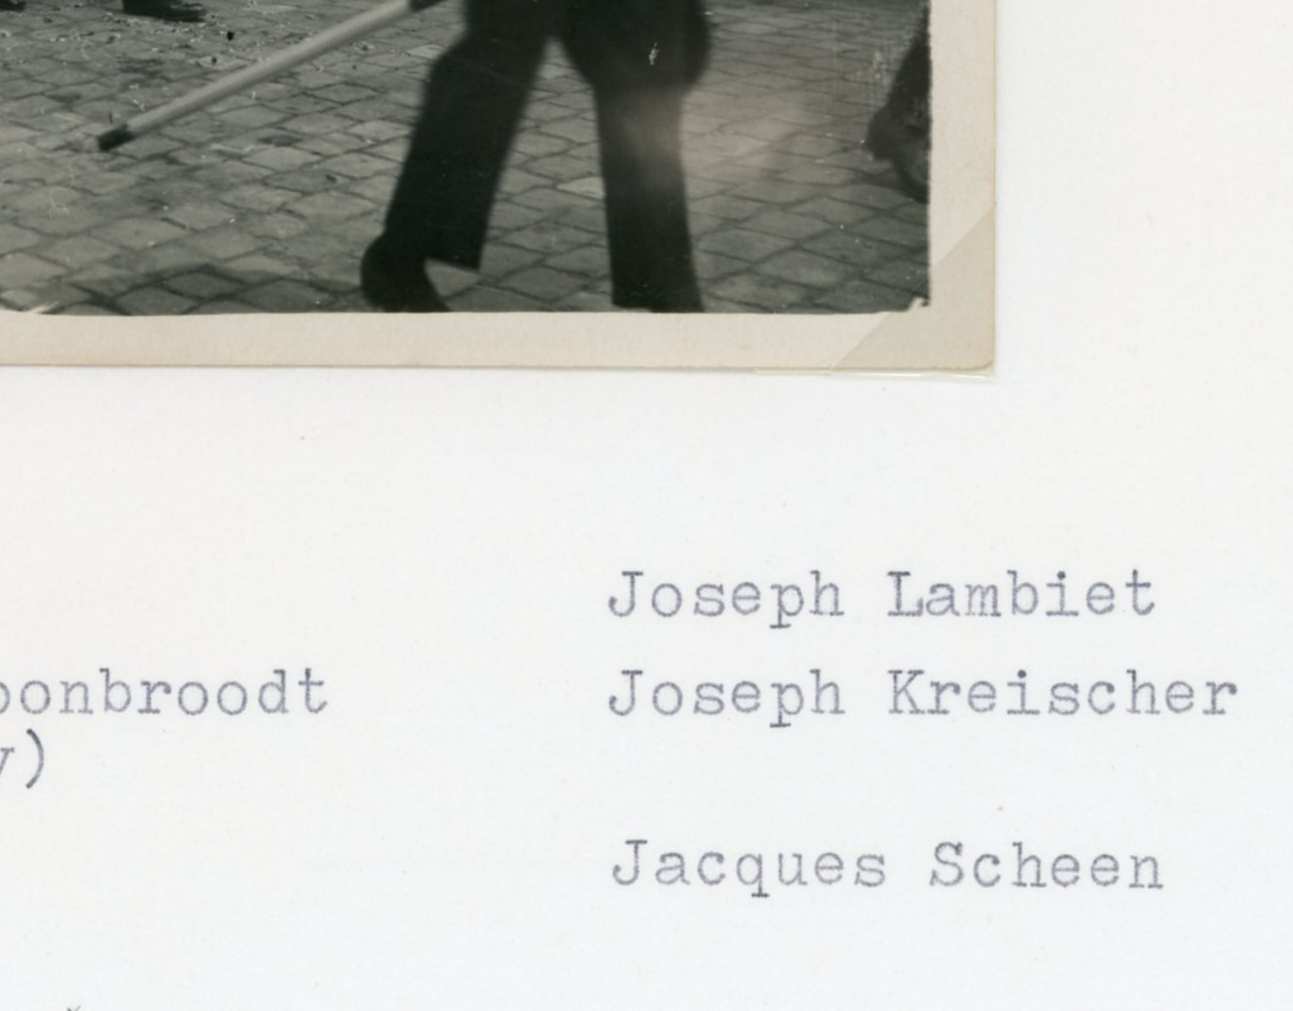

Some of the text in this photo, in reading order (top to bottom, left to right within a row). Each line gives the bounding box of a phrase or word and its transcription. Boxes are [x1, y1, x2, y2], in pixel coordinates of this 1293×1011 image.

[608, 569, 1155, 630] Joseph Lambiet
[608, 668, 1238, 729] Joseph Kreischer
[612, 839, 1164, 899] Jacques Scheen
